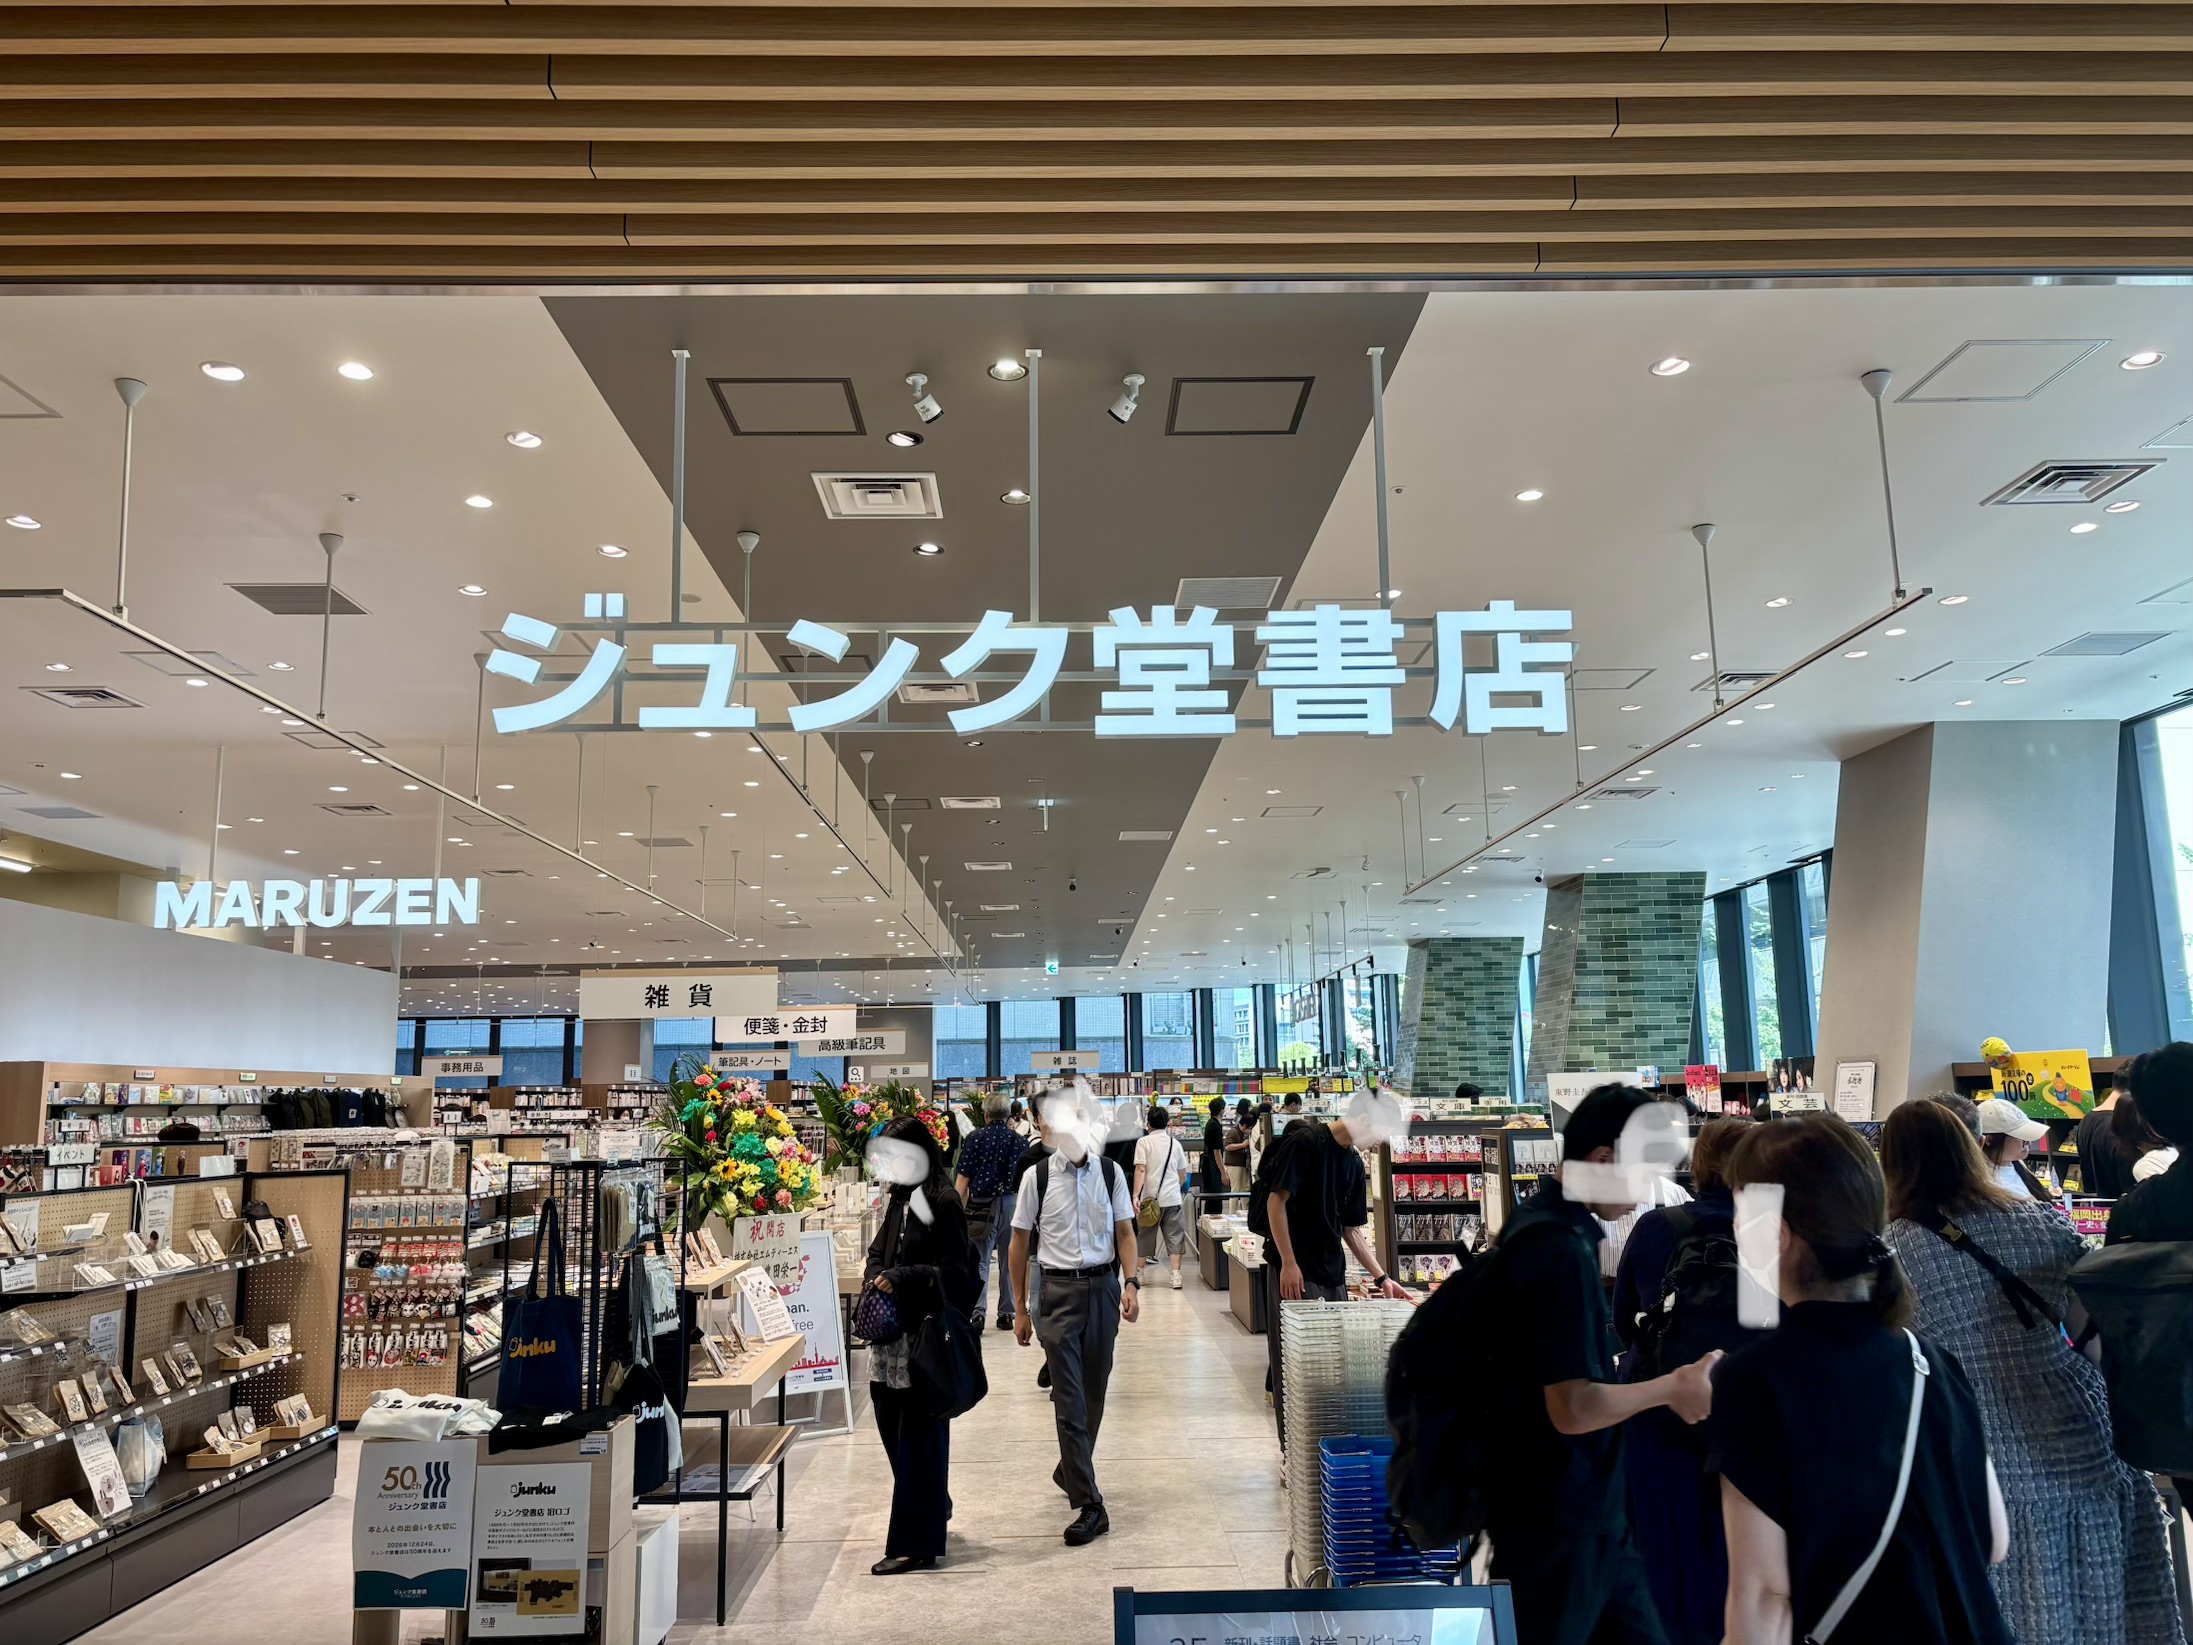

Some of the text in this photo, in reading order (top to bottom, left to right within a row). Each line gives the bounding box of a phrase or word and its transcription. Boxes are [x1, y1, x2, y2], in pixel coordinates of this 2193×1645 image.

[486, 593, 1574, 738] ジュンク堂書店
[154, 878, 480, 928] MARUZEN
[644, 983, 713, 1009] 雑貨
[743, 1016, 828, 1035] 便箋・金封
[818, 1036, 886, 1052] 高級筆記具
[440, 1062, 484, 1073] 事務用品
[718, 1056, 782, 1067] 筆記具・ノート
[1435, 1102, 1465, 1110] 文庫
[1778, 1098, 1819, 1110] 文芸
[57, 1149, 85, 1161] イベント
[376, 1491, 420, 1500] Anniversary
[512, 1481, 557, 1499] junku
[387, 1501, 447, 1512] ジュンク堂書店
[493, 1506, 571, 1518] ジュンク堂書店 旧ロゴ
[367, 1522, 457, 1534] 本と人との出会いを大切に
